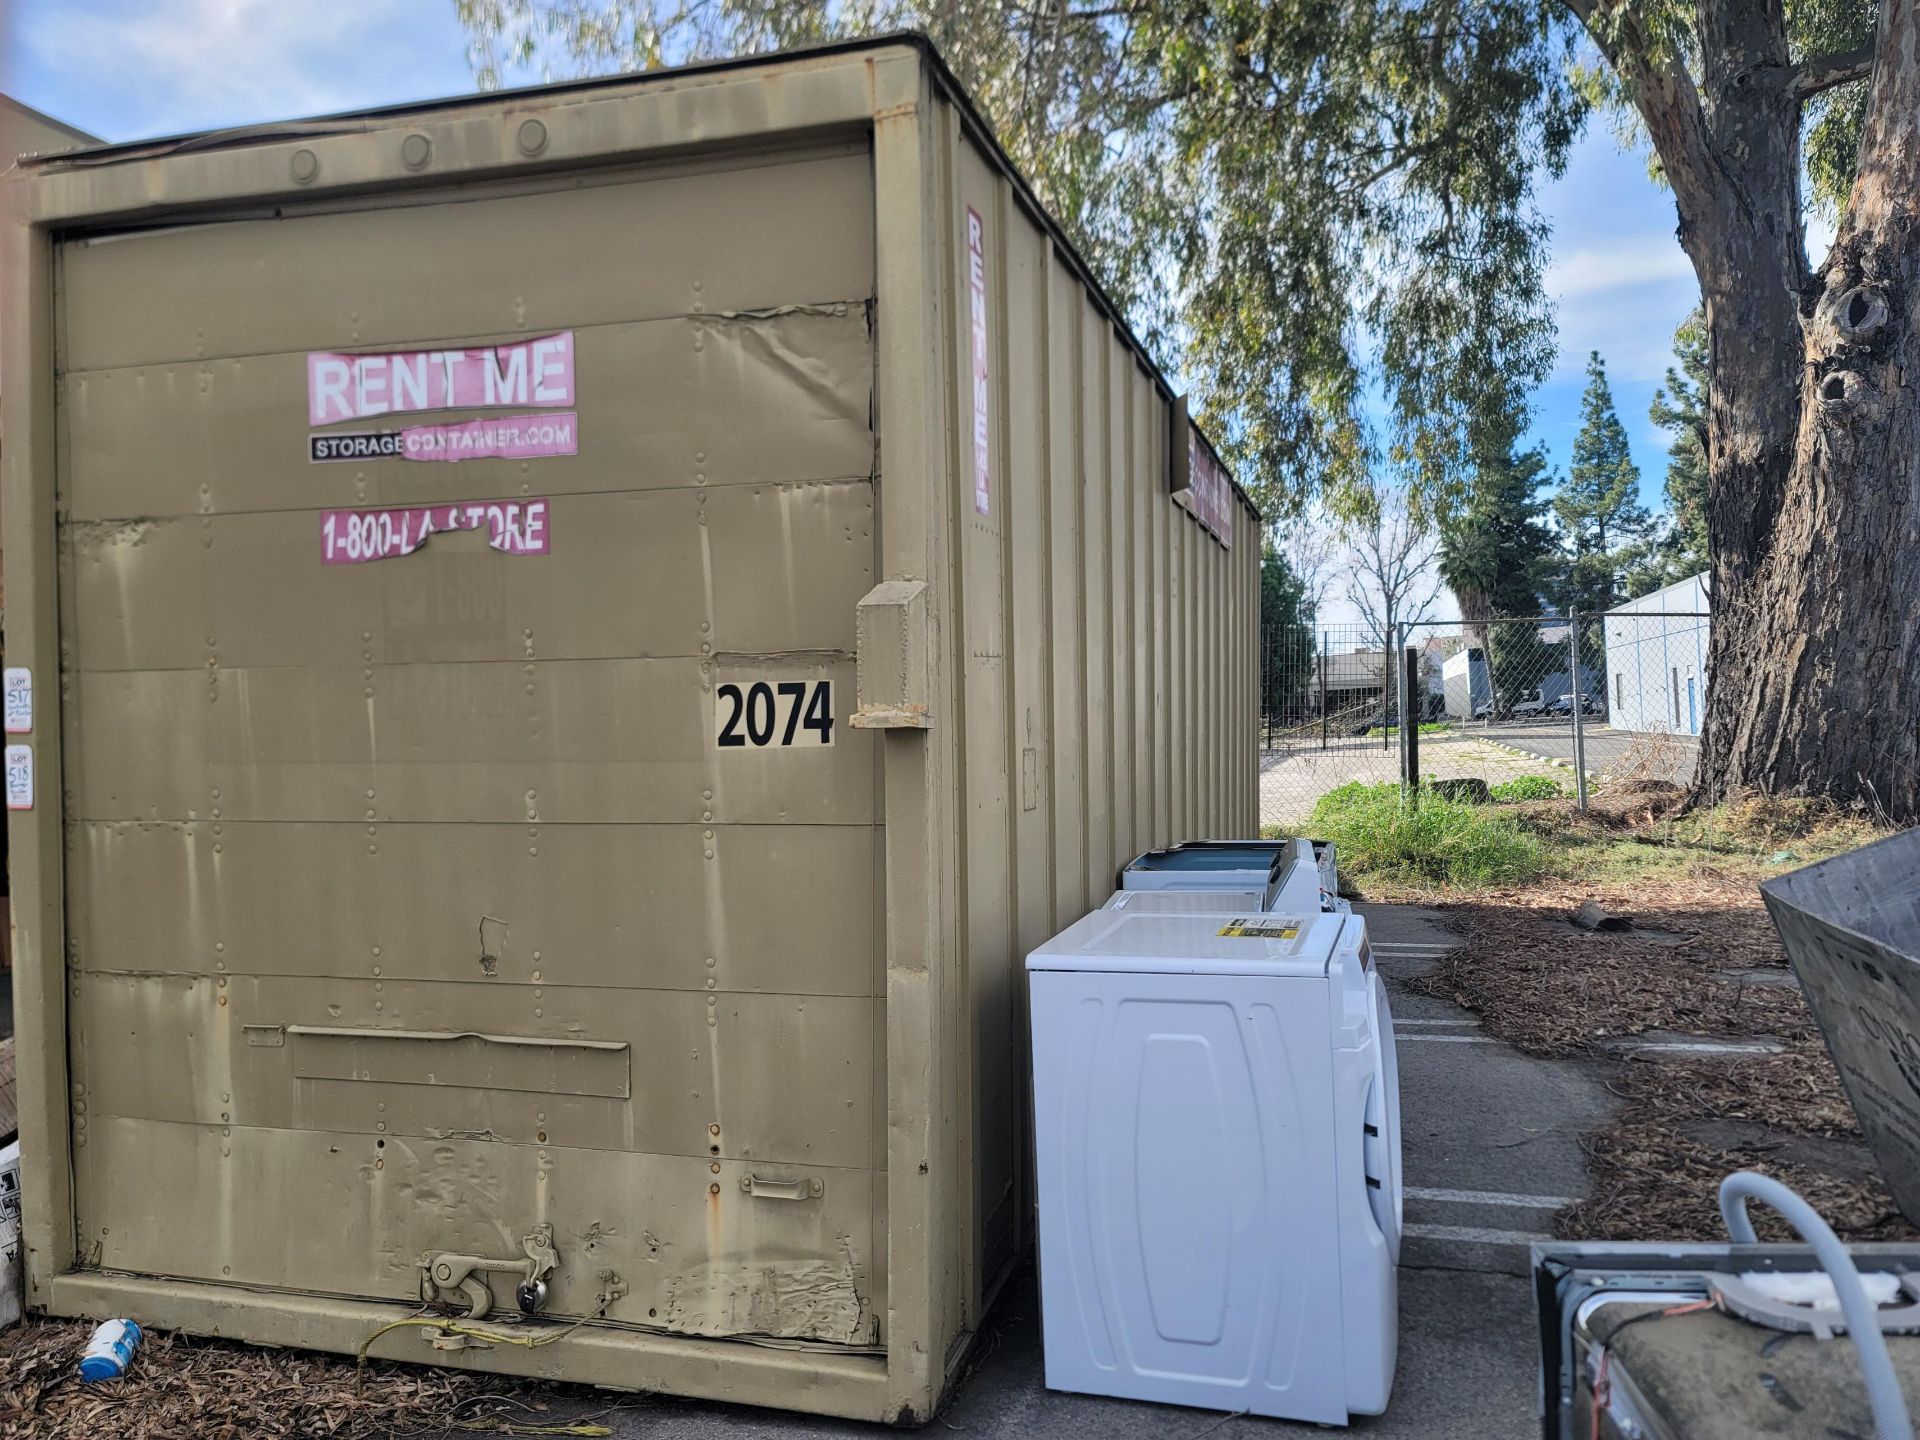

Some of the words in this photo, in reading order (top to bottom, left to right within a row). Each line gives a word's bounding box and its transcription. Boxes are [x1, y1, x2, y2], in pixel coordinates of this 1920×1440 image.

[968, 213, 985, 360] RENT
[314, 351, 465, 419] RENT
[484, 340, 568, 406] ME
[974, 376, 988, 448] ME
[8, 688, 32, 703] 517
[717, 681, 834, 747] 2074
[9, 766, 29, 784] 518
